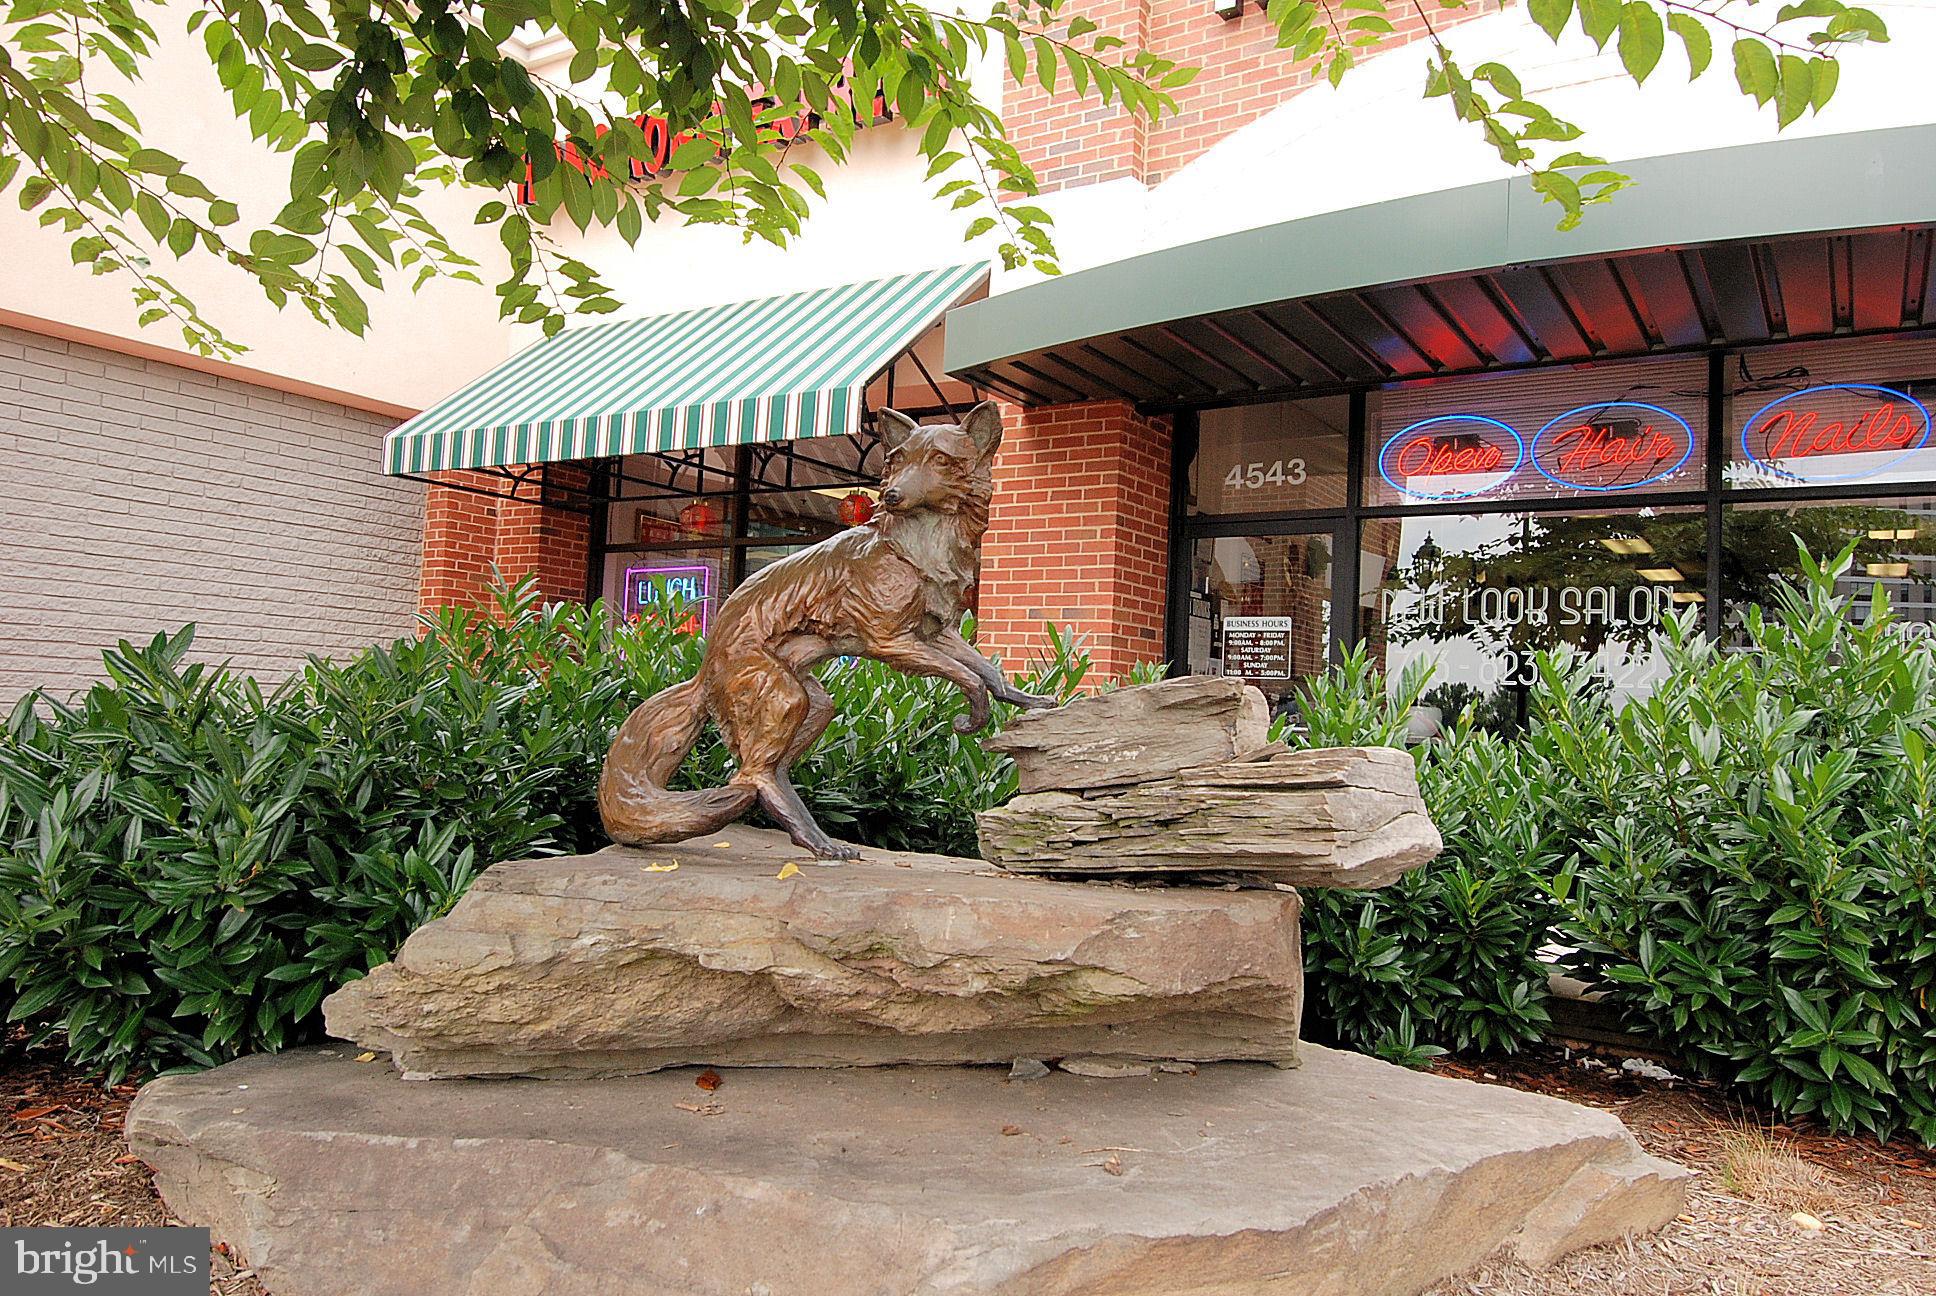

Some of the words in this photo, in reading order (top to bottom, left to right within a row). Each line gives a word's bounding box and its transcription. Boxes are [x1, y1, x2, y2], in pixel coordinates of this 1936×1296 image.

[1552, 425, 1677, 473] Hair
[1759, 403, 1918, 458] Nails
[1224, 458, 1307, 489] 4543
[1398, 437, 1503, 486] Open
[1226, 620, 1260, 628] BUSINESS
[1261, 620, 1288, 628] HOURS
[1463, 586, 1549, 625] LOOK
[1559, 585, 1675, 626] SALON
